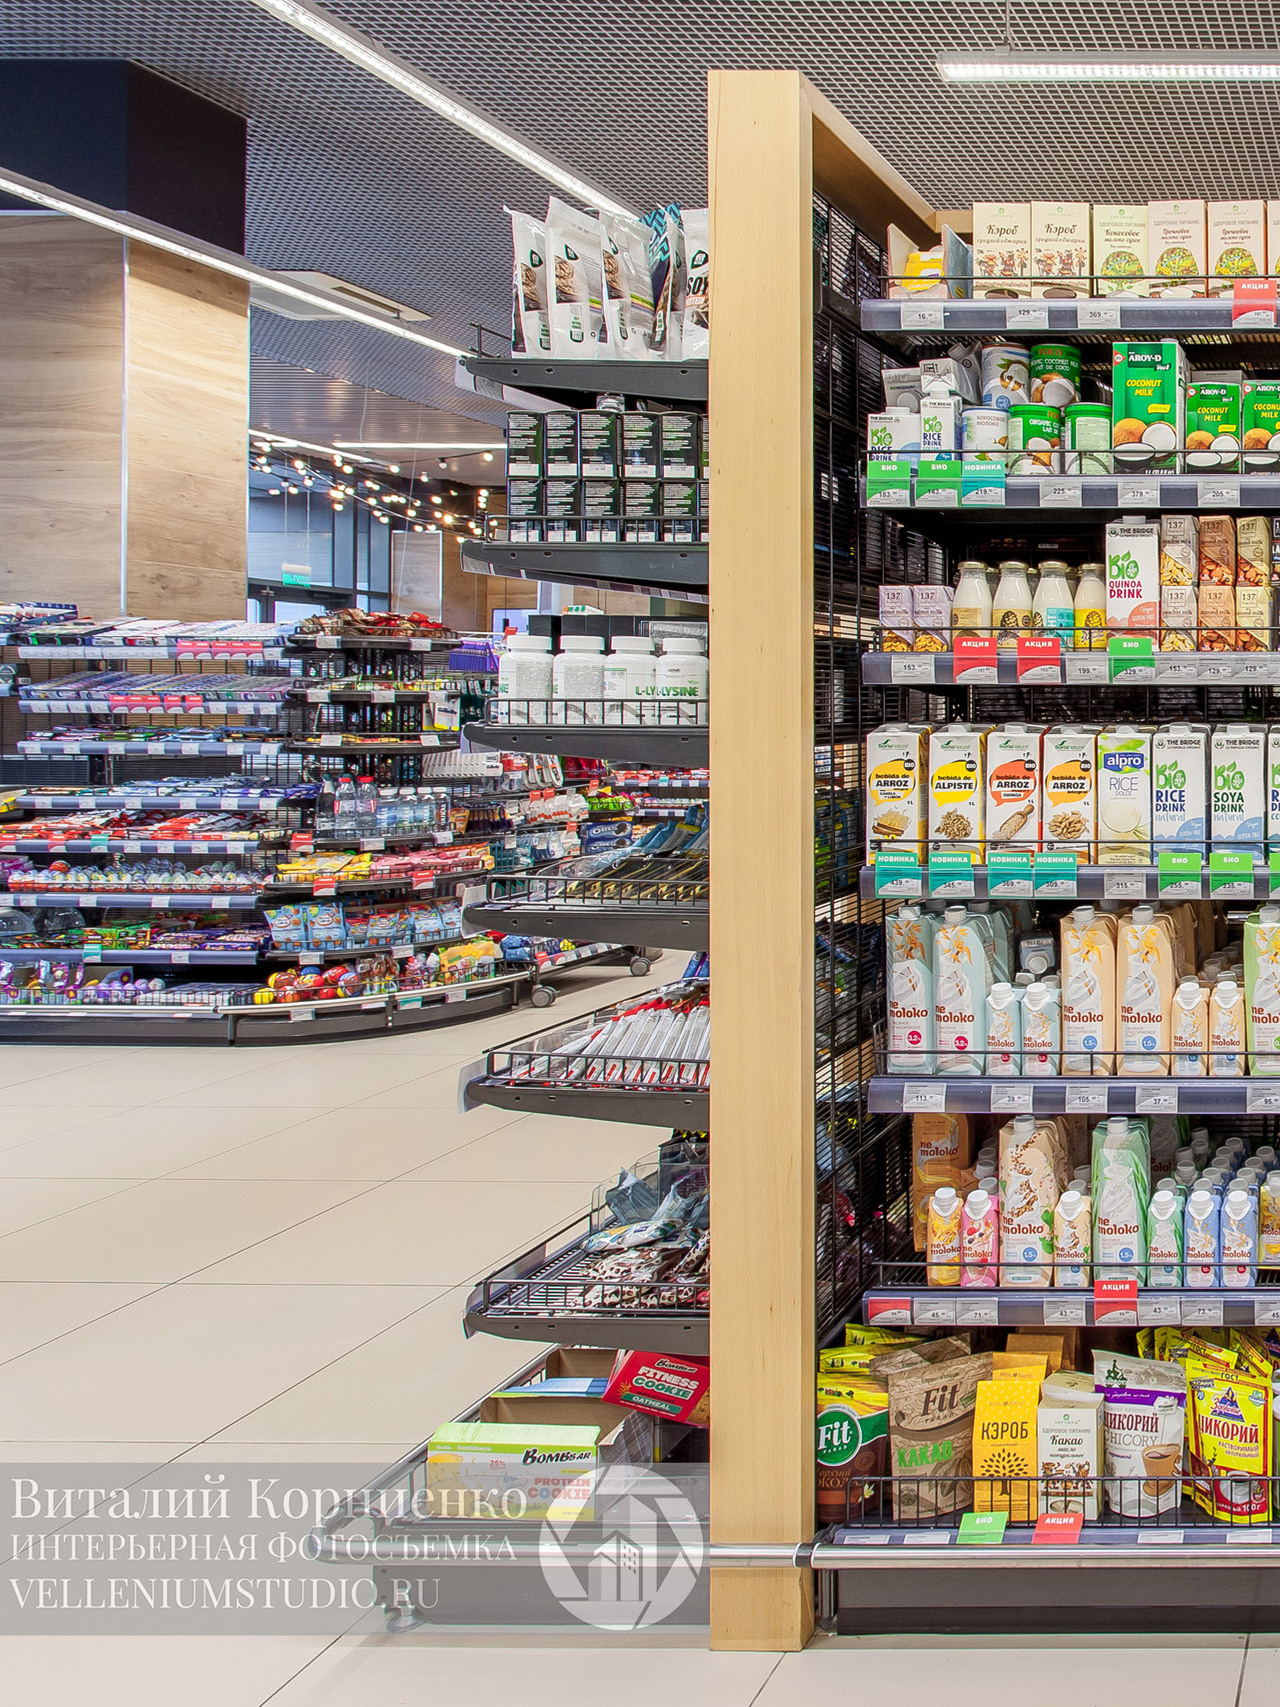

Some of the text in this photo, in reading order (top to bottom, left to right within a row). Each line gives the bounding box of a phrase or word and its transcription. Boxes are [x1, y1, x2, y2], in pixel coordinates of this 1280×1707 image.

[986, 224, 1019, 236] Кэроб
[1044, 223, 1077, 235] Кэроб
[1241, 282, 1269, 290] АКЦИЯ
[1128, 354, 1162, 362] AROY-D
[1126, 379, 1162, 387] COCONUT
[1134, 388, 1153, 396] MILK
[1261, 411, 1279, 419] MILK
[923, 433, 942, 441] RICE
[886, 592, 901, 600] 137
[920, 592, 935, 600] 137
[1110, 589, 1142, 599] DRINK
[1107, 754, 1141, 768] alpro
[876, 779, 909, 788] ARROZ
[935, 781, 973, 790] ALPISTE
[996, 780, 1029, 789] ARROZ
[1052, 781, 1085, 789] ARROZ
[1109, 777, 1138, 791] RICE
[1156, 790, 1185, 802] RICE
[1214, 792, 1244, 803] SOYA
[878, 855, 915, 863] НОВИНКА
[890, 1001, 898, 1009] ne
[935, 1005, 946, 1014] ne
[890, 1008, 929, 1018] moloko
[935, 1012, 975, 1023] moloko
[1121, 1012, 1162, 1023] moloko
[638, 1366, 699, 1389] FITNESS
[1221, 1372, 1239, 1380] ГОСТ
[633, 1377, 694, 1400] COOKIE
[632, 1395, 671, 1411] OATMEAL
[922, 1384, 959, 1417] Fit
[818, 1420, 851, 1450] Fit
[981, 1421, 1028, 1440] КЭРОБ
[1050, 1434, 1084, 1446] Какао
[1218, 1441, 1259, 1451] РАСТВОРИМЫЙ
[898, 1440, 952, 1467] КАКАО
[534, 1477, 590, 1487] PROTEIN
[528, 1487, 590, 1500] COOKIE
